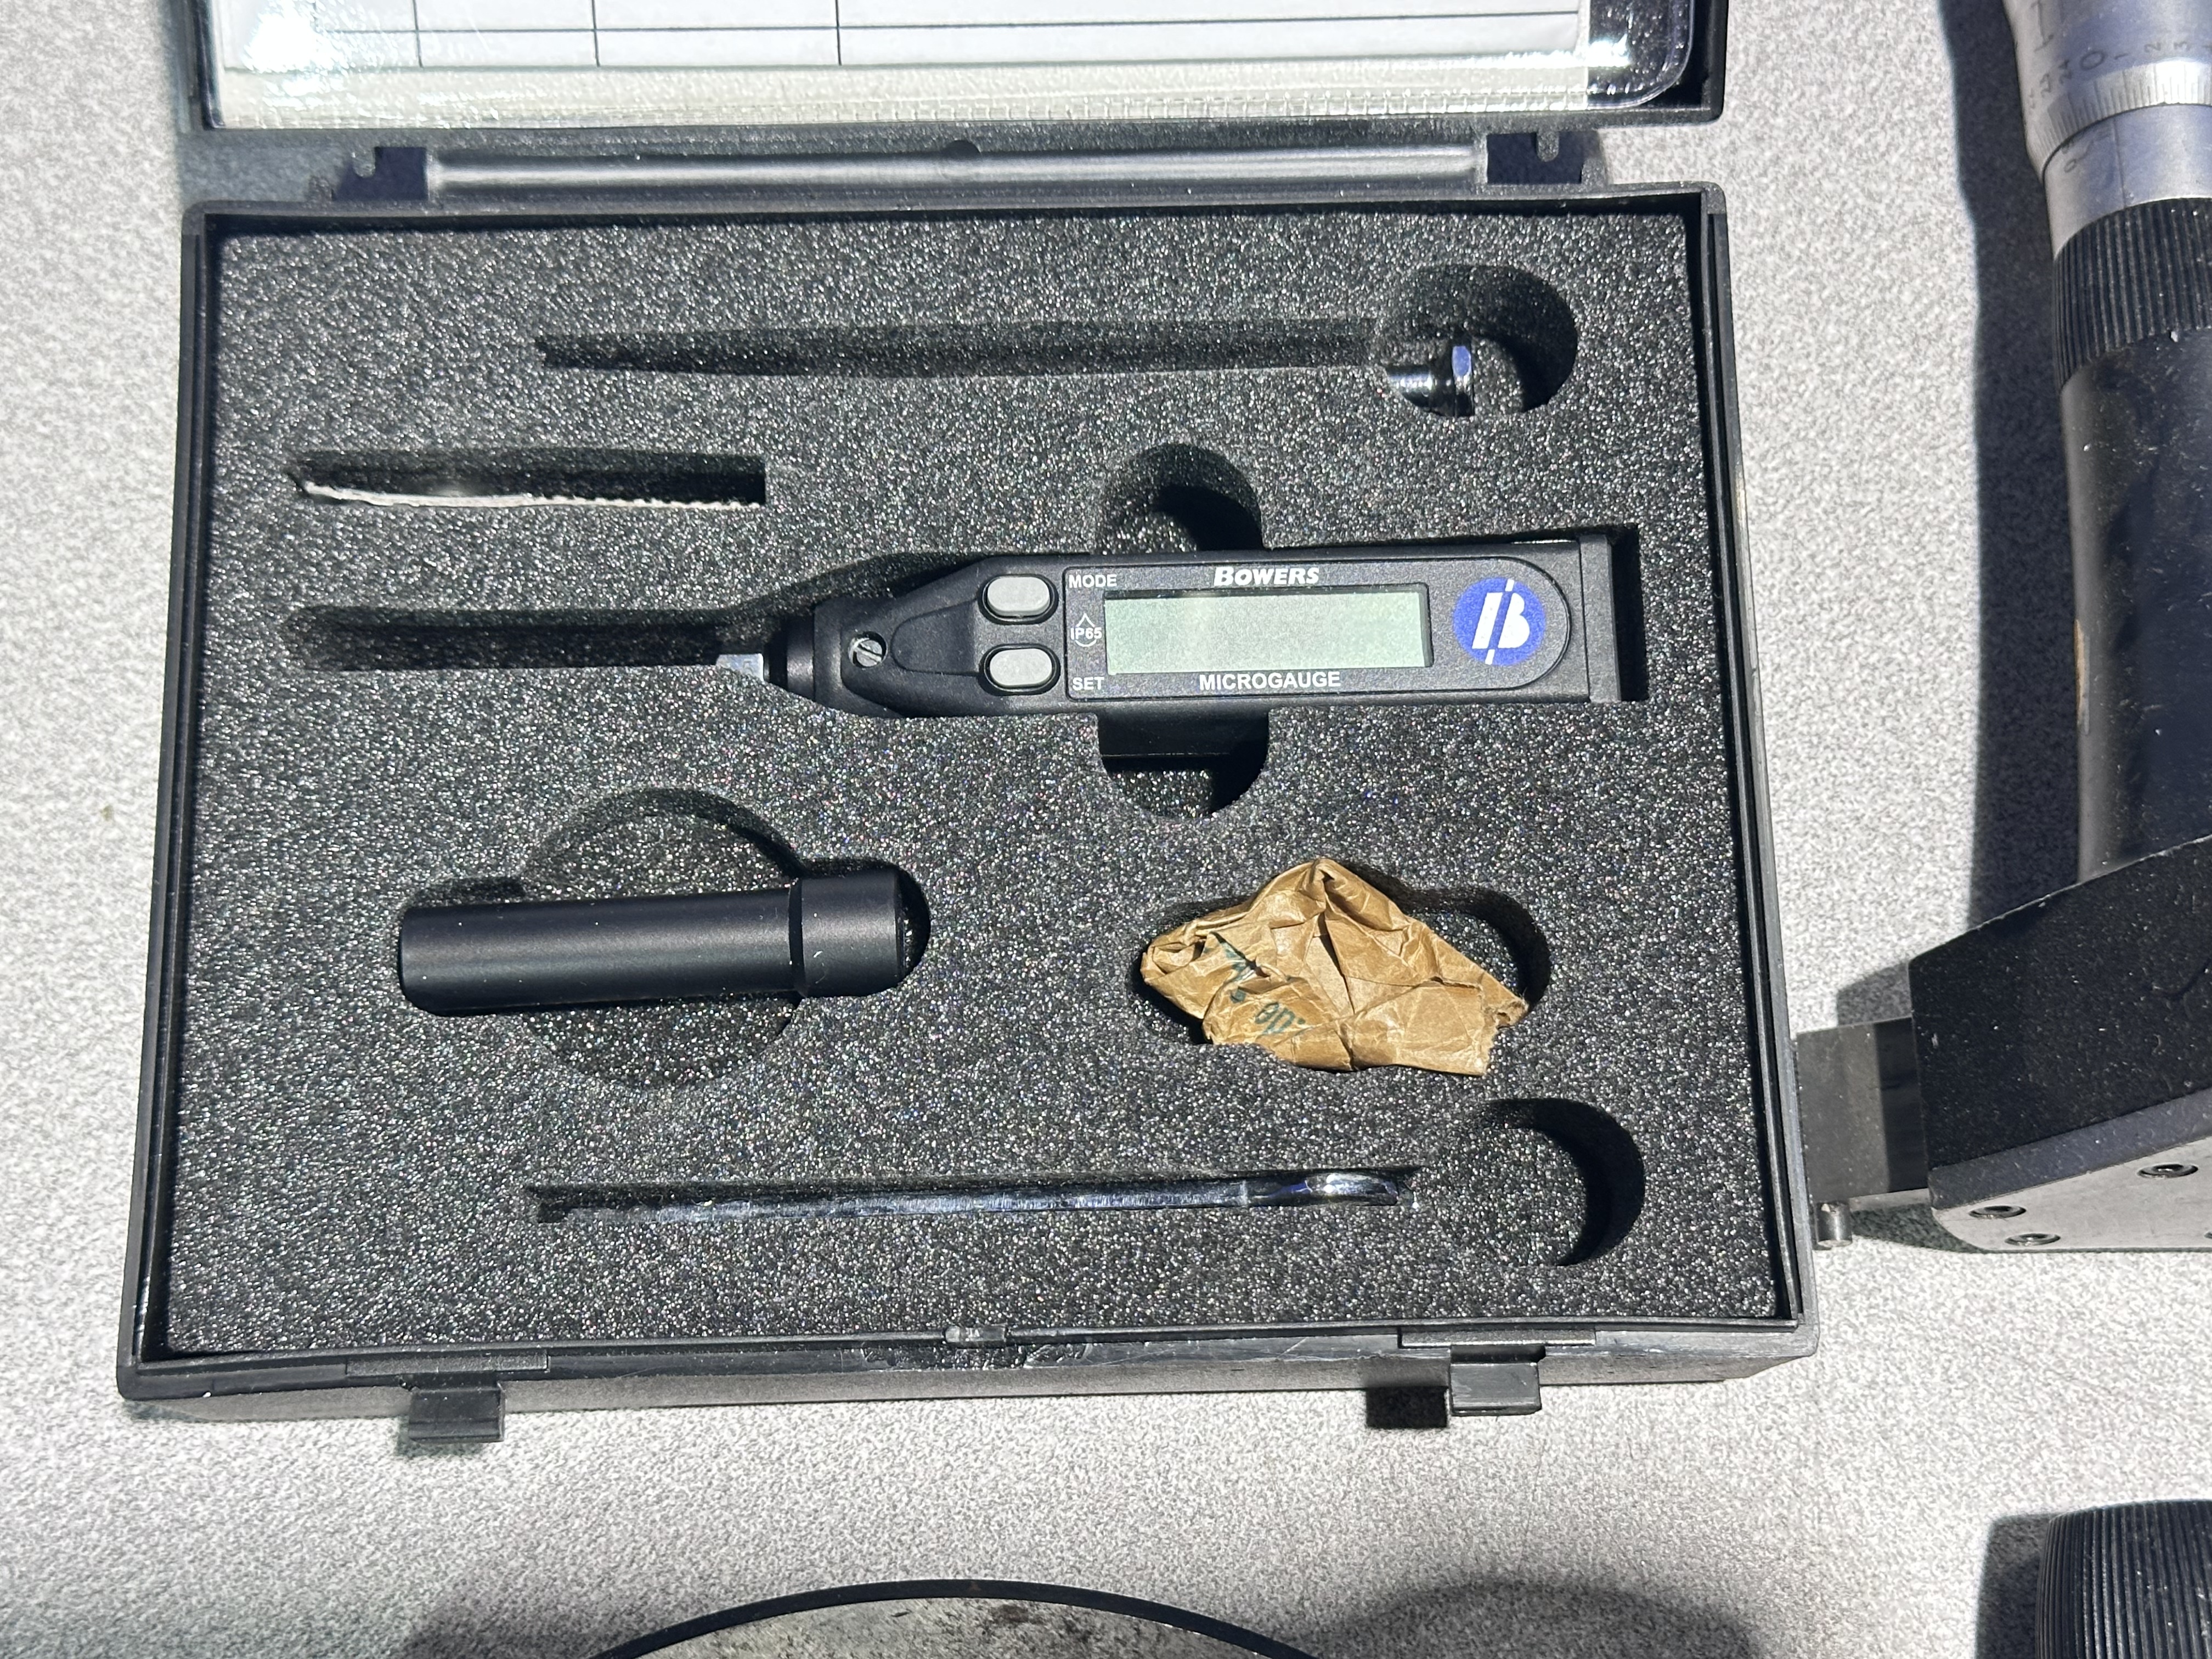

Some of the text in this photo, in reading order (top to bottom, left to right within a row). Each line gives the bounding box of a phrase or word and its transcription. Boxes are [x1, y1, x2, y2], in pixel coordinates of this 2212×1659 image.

[1069, 574, 1118, 588] MODE
[1214, 566, 1319, 586] BOWERS
[1070, 627, 1102, 640] IP65
[1073, 676, 1104, 691] SET
[1199, 671, 1341, 691] MICROGAUGE
